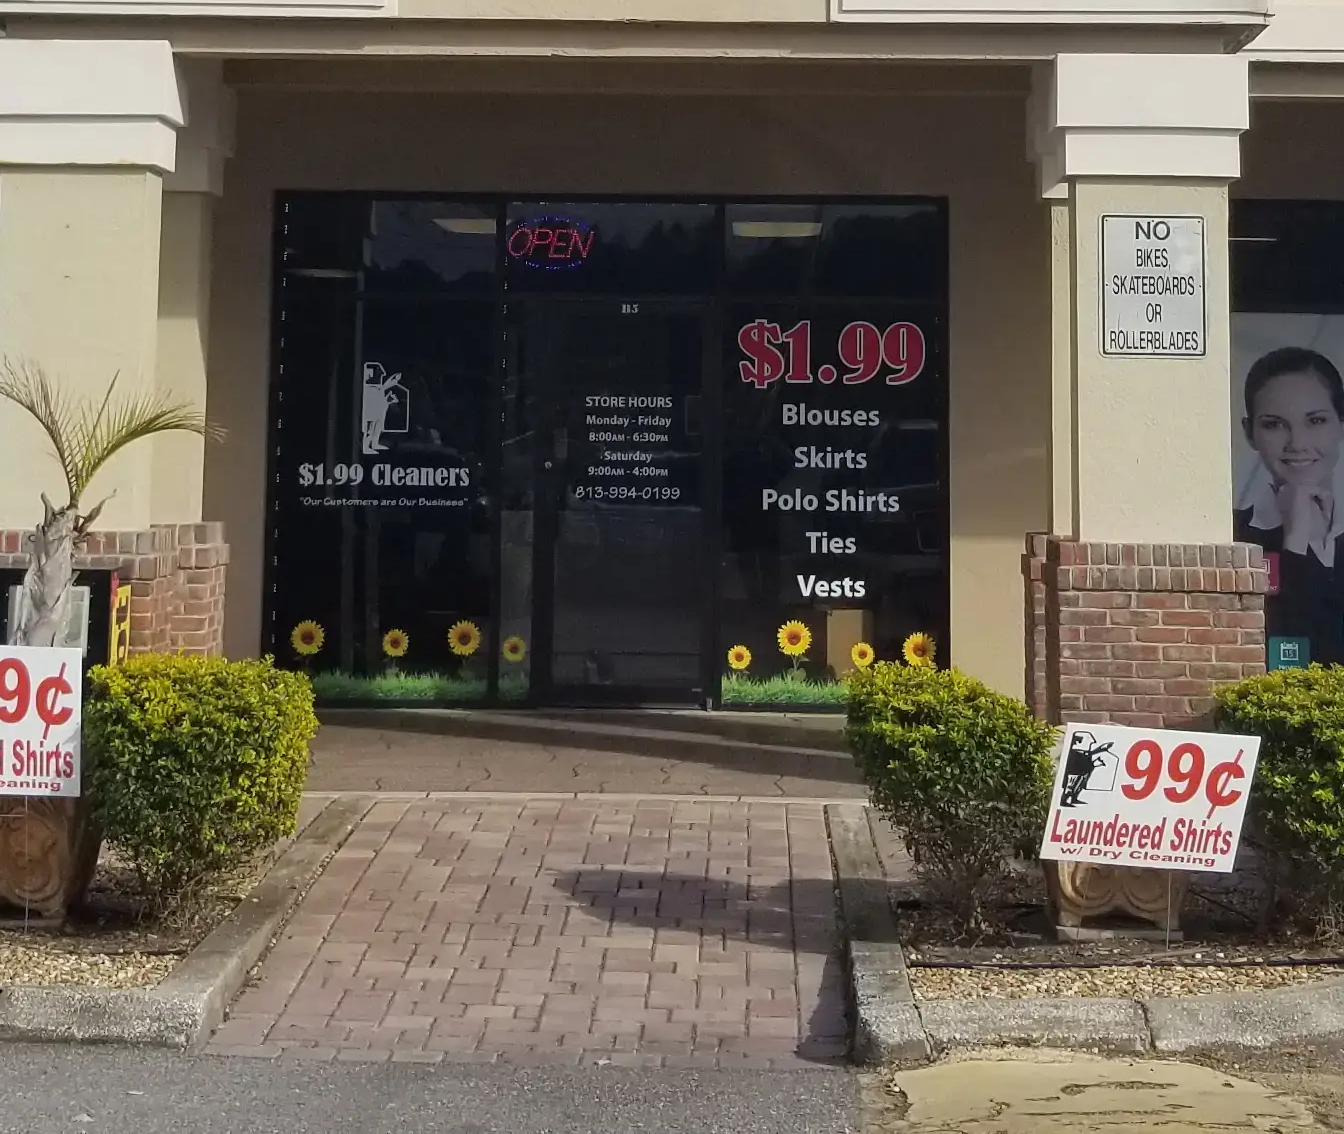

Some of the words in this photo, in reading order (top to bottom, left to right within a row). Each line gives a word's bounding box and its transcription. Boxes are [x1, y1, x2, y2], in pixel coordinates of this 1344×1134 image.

[1135, 221, 1171, 241] NO
[508, 227, 594, 258] OPEN
[1112, 275, 1195, 296] SKATEBOARDS
[1146, 302, 1162, 323] OR
[1109, 330, 1199, 351] ROLLERBLADES
[738, 319, 926, 389] $1.99
[585, 396, 626, 407] STORE
[628, 396, 673, 407] HOURS
[586, 415, 629, 427] Monday
[638, 415, 672, 428] Friday
[782, 403, 880, 427] Blouses
[588, 432, 625, 442] 8:00AM
[632, 432, 669, 442] 6:30PM
[604, 451, 652, 463] Saturday
[794, 446, 868, 469] Skirts
[298, 463, 364, 488] $1.99
[371, 463, 470, 487] Cleaners
[588, 466, 624, 476] 9:00AM
[632, 466, 668, 476] 4:00PM
[323, 497, 378, 506] Customers
[380, 498, 396, 506] are
[398, 497, 417, 506] Our
[576, 486, 680, 500] 813-994-0199
[762, 488, 819, 511] Polo
[825, 489, 900, 513] Shirts
[806, 531, 857, 554] Ties
[796, 574, 866, 598] Vests
[12, 739, 74, 779] Shirts
[1120, 739, 1246, 820] 99¢
[1050, 809, 1167, 851] Laundered
[1170, 817, 1233, 856] Shirts
[1060, 846, 1084, 856] w/
[1089, 847, 1123, 860] Dry
[1129, 851, 1216, 867] Cleaning
